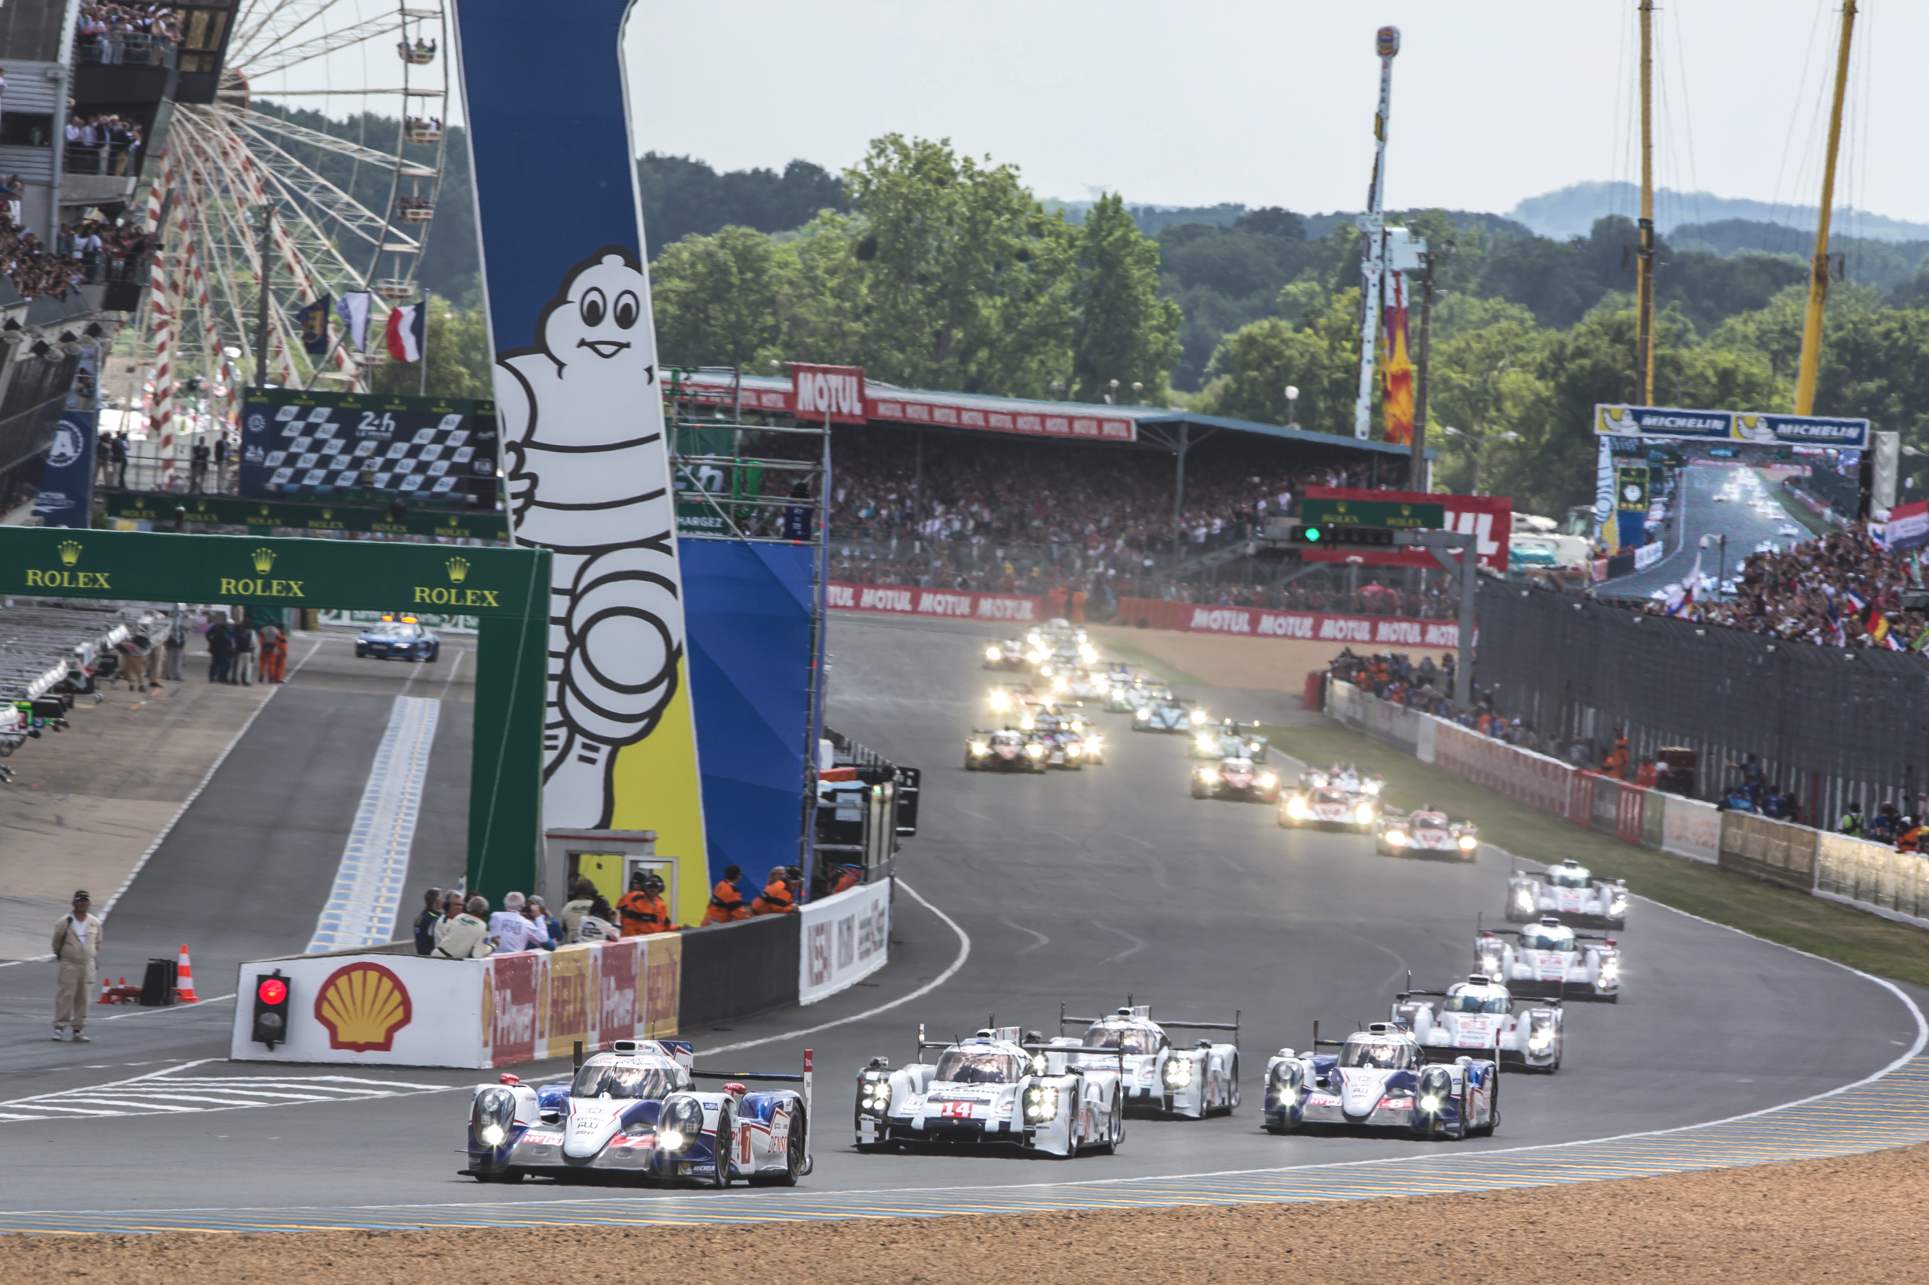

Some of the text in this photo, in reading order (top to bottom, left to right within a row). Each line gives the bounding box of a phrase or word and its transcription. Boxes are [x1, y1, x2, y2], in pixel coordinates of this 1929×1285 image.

[798, 371, 862, 415] MOTUL
[1640, 416, 1727, 431] MICHELIN
[1776, 423, 1861, 439] MICHELIN
[26, 569, 111, 590] ROLEX
[219, 577, 305, 598] ROLEX
[413, 586, 499, 608] ROLEX
[859, 588, 913, 612] MOTUL
[917, 592, 972, 615] MOTUL
[1191, 608, 1251, 633] MOTUL
[1257, 613, 1314, 638] MOTUL
[1319, 618, 1371, 642] MOTUL
[1376, 622, 1422, 644] MOTUL
[943, 1102, 972, 1117] 14
